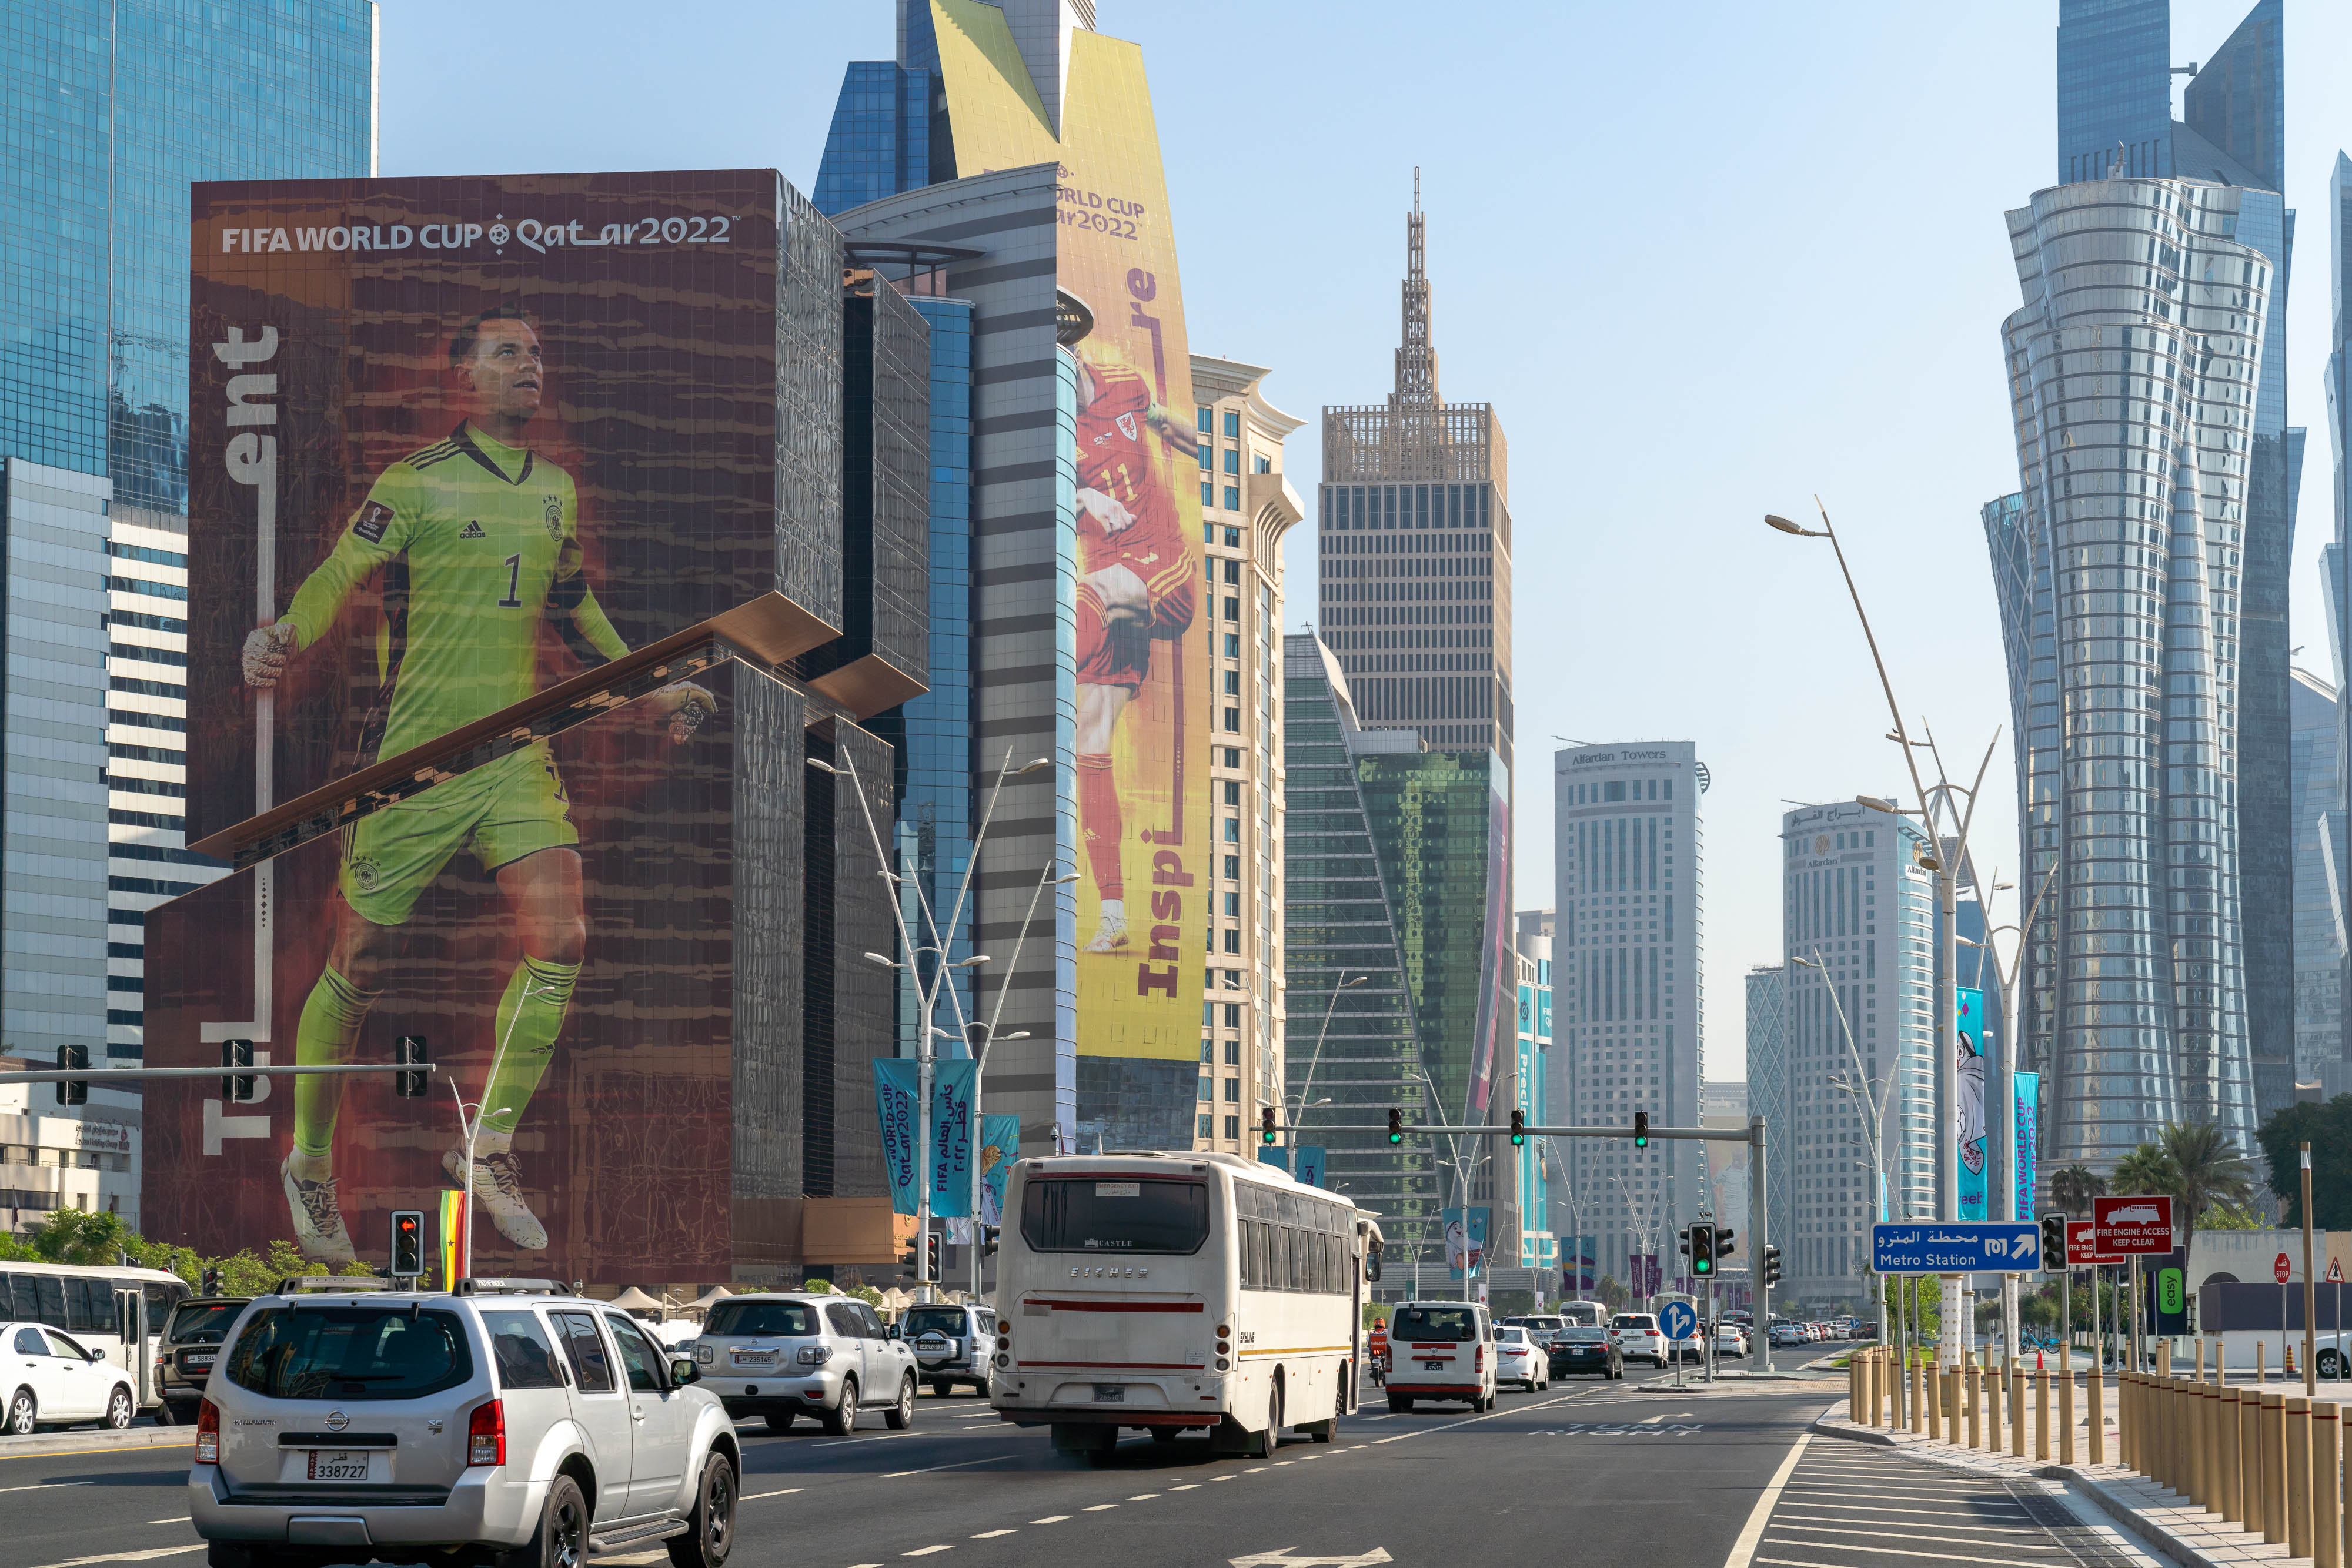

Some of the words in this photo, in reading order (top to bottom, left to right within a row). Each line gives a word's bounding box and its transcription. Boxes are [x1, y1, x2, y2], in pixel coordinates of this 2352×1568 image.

[1107, 197, 1145, 218] CUP
[222, 228, 292, 253] FIFA
[295, 225, 413, 252] WORLD
[419, 223, 482, 248] CUP
[516, 216, 730, 255] Qatar2022
[1101, 463, 1138, 502] 11
[459, 530, 486, 539] adidas
[498, 553, 522, 608] 1
[1572, 753, 1615, 765] Alfardan
[1621, 751, 1666, 760] Towers
[1808, 858, 1838, 868] Alfardan
[883, 1084, 893, 1110] CUP
[940, 1084, 955, 1117] كأس
[2017, 1096, 2026, 1126] CUP
[955, 1101, 968, 1143] قطر
[895, 1091, 914, 1189] Qatar2022
[938, 1121, 951, 1158] العالم
[2017, 1129, 2027, 1185] WORLD
[937, 1162, 947, 1192] FIFA
[2019, 1187, 2029, 1221] FIFA
[1877, 1231, 1920, 1248] المترو
[1927, 1231, 1979, 1243] محطة
[2097, 1228, 2112, 1236] FIRE
[2113, 1228, 2141, 1236] ENGINE
[2142, 1227, 2170, 1236] ACCESS
[2132, 1238, 2155, 1246] CLEAR
[1880, 1254, 1920, 1266] Metro
[1926, 1253, 1976, 1265] Station
[2278, 1258, 2287, 1266] قف
[1070, 1267, 1148, 1278] EICHER
[2167, 1276, 2178, 1306] easy
[1099, 1393, 1123, 1401] 265101
[329, 1453, 348, 1463] قطر
[318, 1466, 366, 1479] 338727
